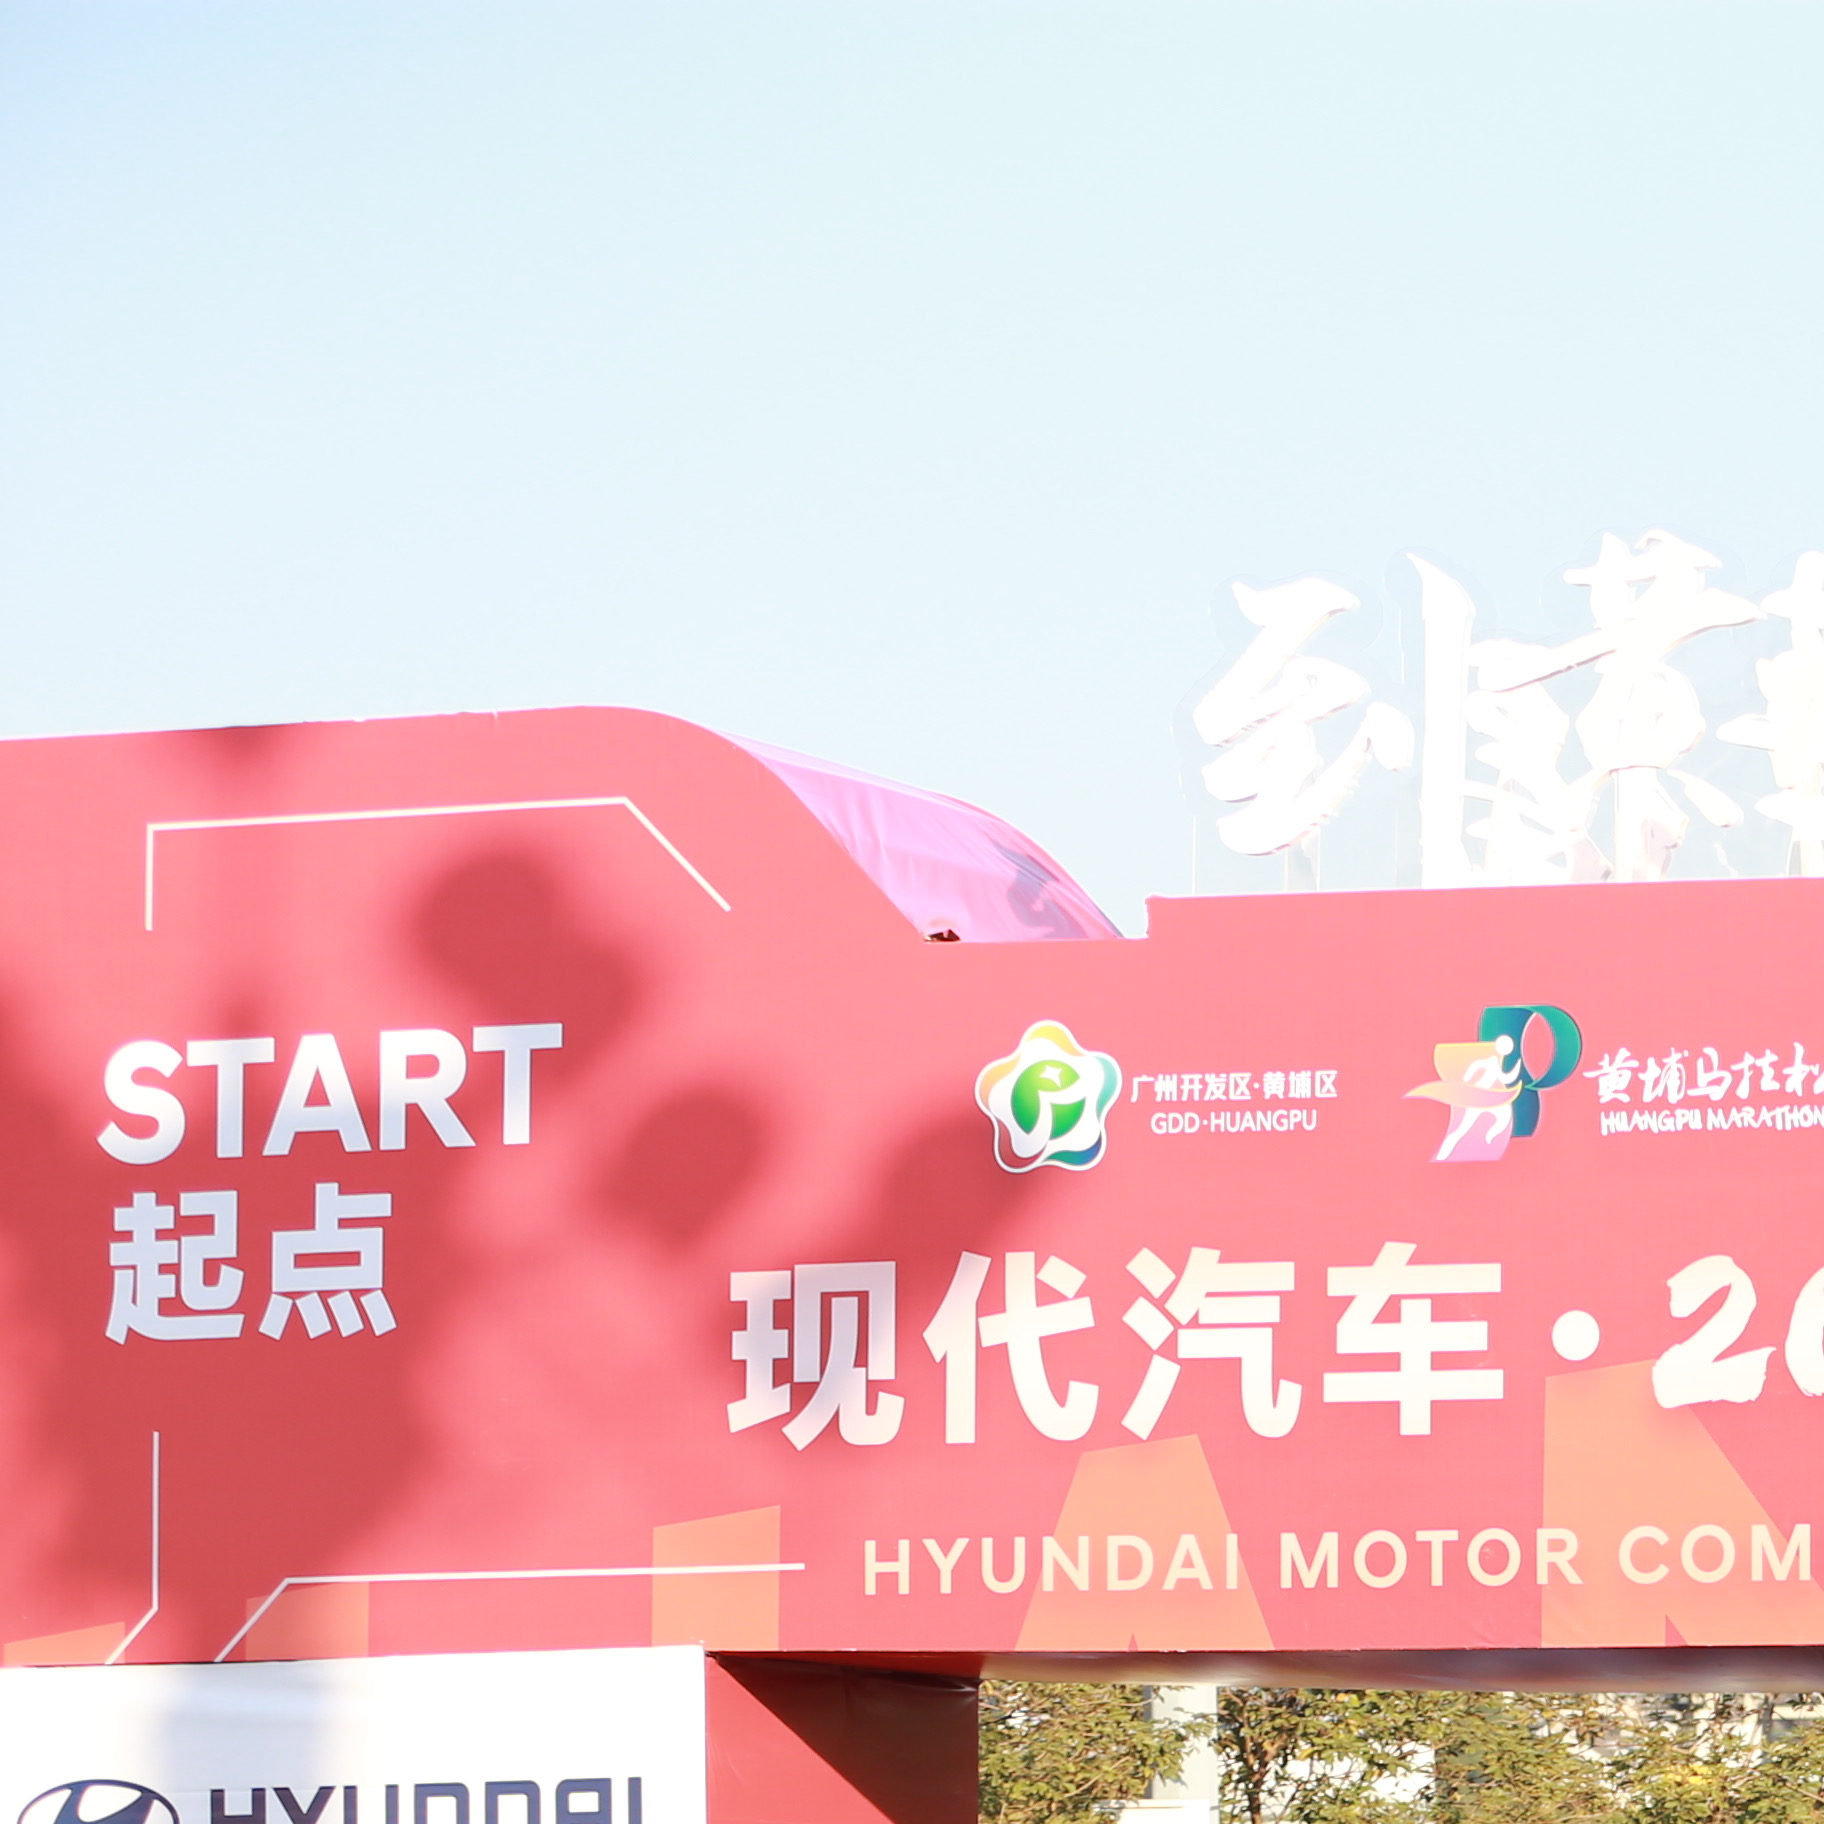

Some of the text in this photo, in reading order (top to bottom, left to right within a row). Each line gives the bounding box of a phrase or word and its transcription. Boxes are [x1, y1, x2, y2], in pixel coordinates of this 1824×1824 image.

[97, 1022, 563, 1166] START
[1600, 1107, 1703, 1136] HUANGPU
[104, 1182, 397, 1346] 起点
[864, 1533, 1239, 1596] HYUNDAI
[1279, 1528, 1584, 1591] MOTOR
